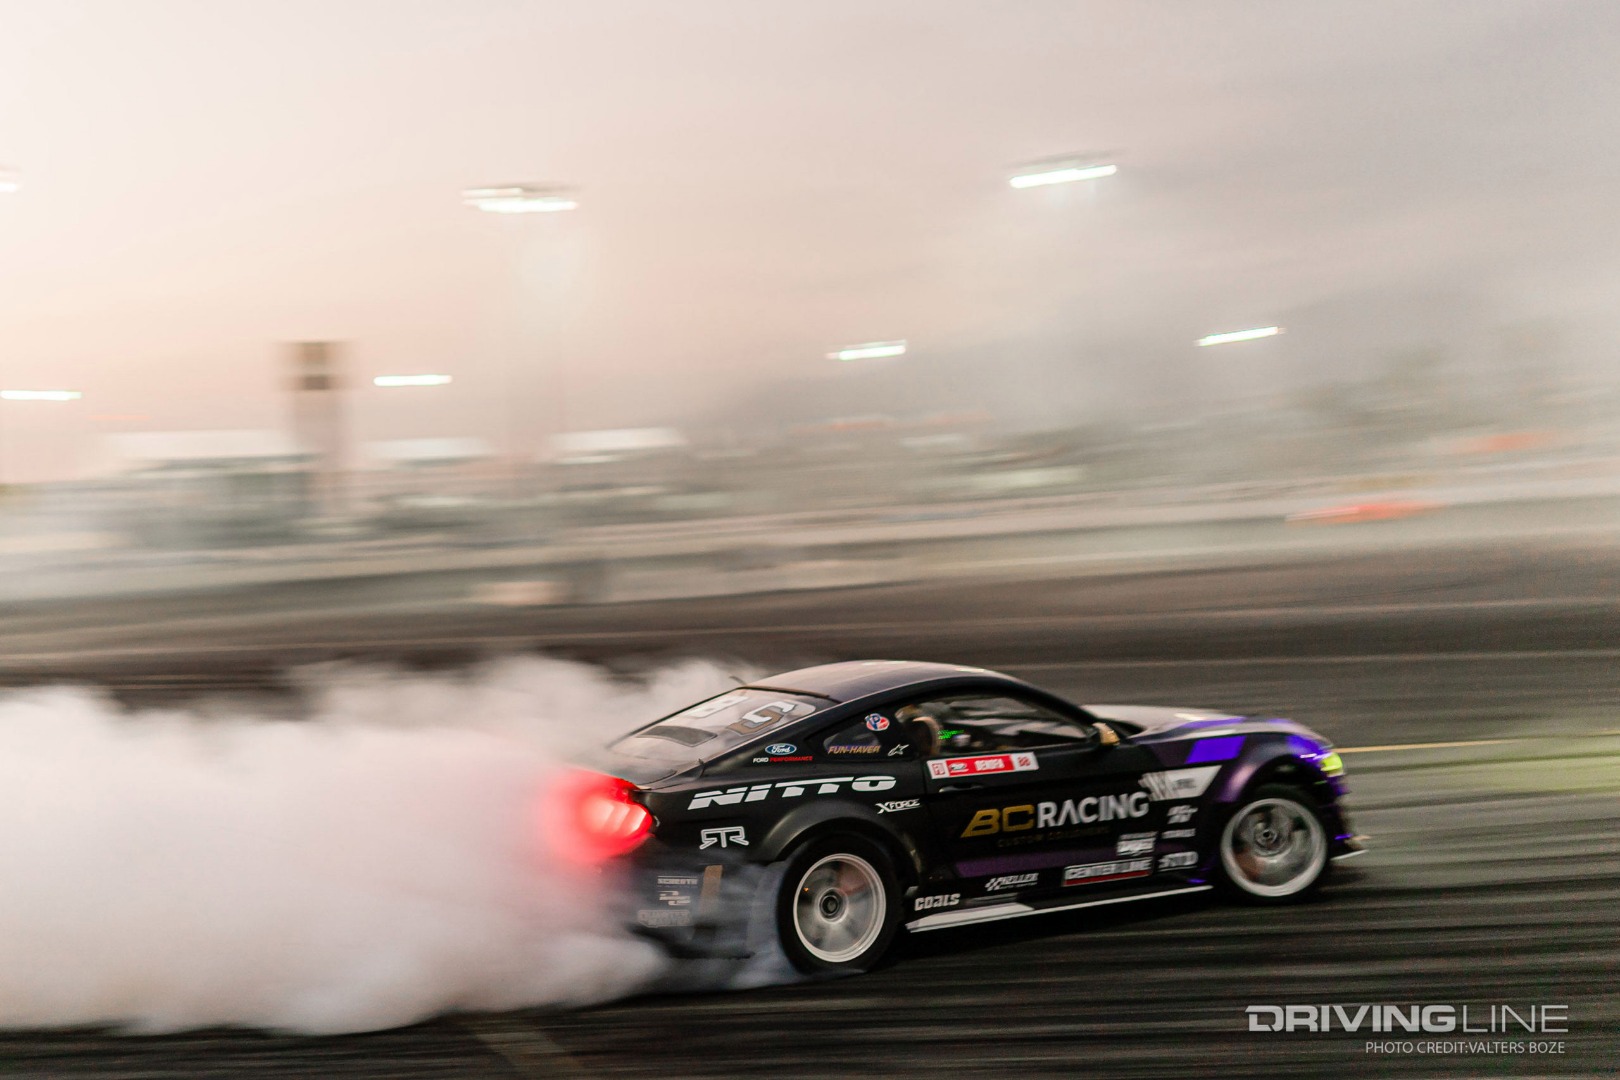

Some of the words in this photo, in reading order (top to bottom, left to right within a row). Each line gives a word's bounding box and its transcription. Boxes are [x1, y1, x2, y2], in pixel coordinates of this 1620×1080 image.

[828, 745, 881, 755] FUN-HAVER
[688, 776, 896, 810] NITTO
[1037, 791, 1150, 829] RACING
